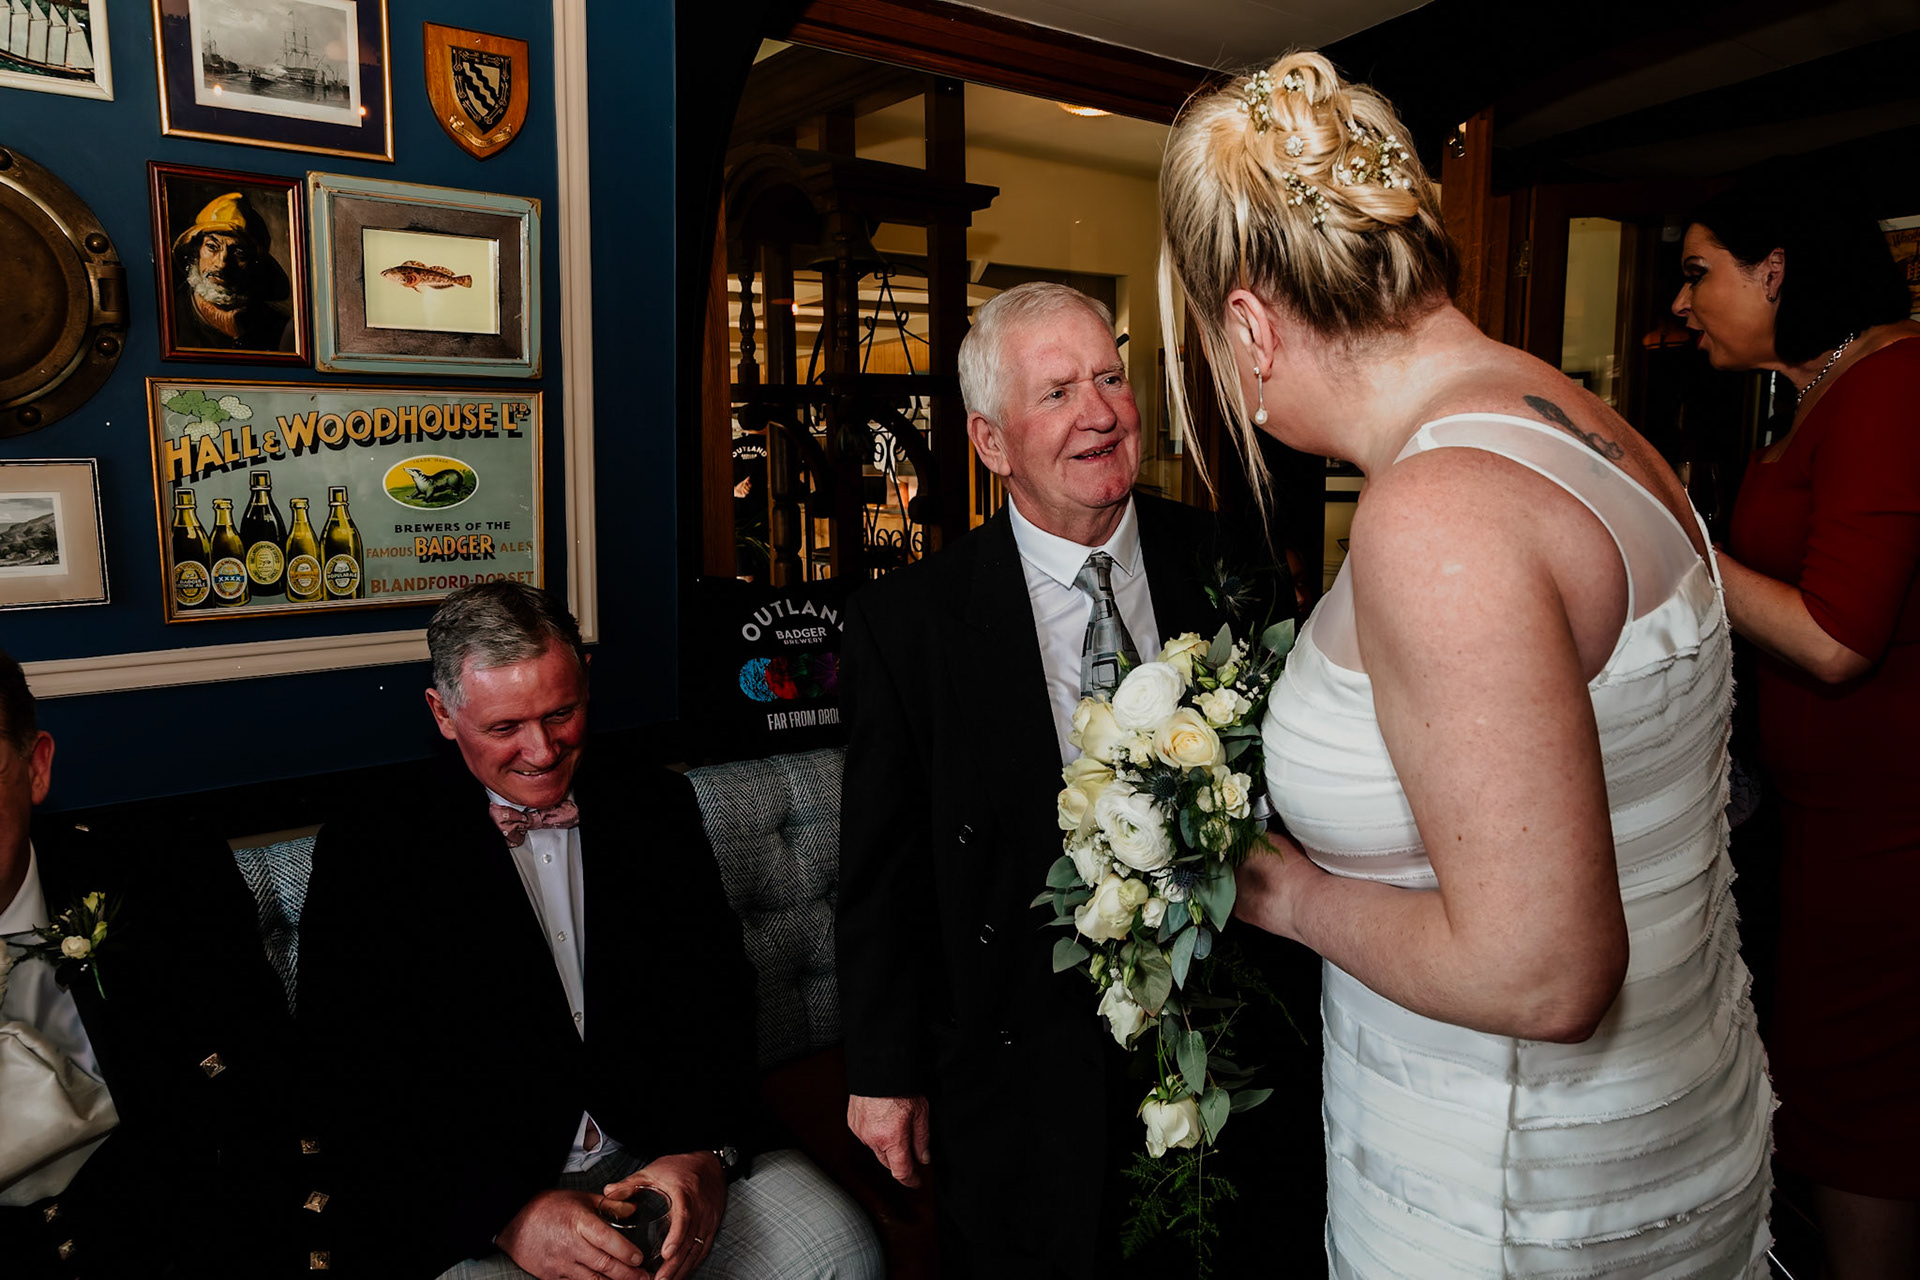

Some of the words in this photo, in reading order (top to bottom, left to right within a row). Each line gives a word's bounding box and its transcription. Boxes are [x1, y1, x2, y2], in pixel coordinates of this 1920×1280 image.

[165, 425, 260, 483] HALL
[263, 430, 281, 454] &
[277, 403, 496, 450] WOODHOUSE
[394, 522, 460, 533] BREWERS
[465, 522, 482, 531] OF
[486, 521, 511, 531] THE
[366, 547, 413, 558] FAMOUS
[414, 534, 494, 557] BADGER
[500, 542, 533, 553] ALES
[742, 599, 845, 642] OUTLAN
[775, 627, 827, 640] BADGER
[783, 637, 823, 645] BREWERY
[767, 712, 789, 731] FAR
[789, 710, 817, 727] FROM
